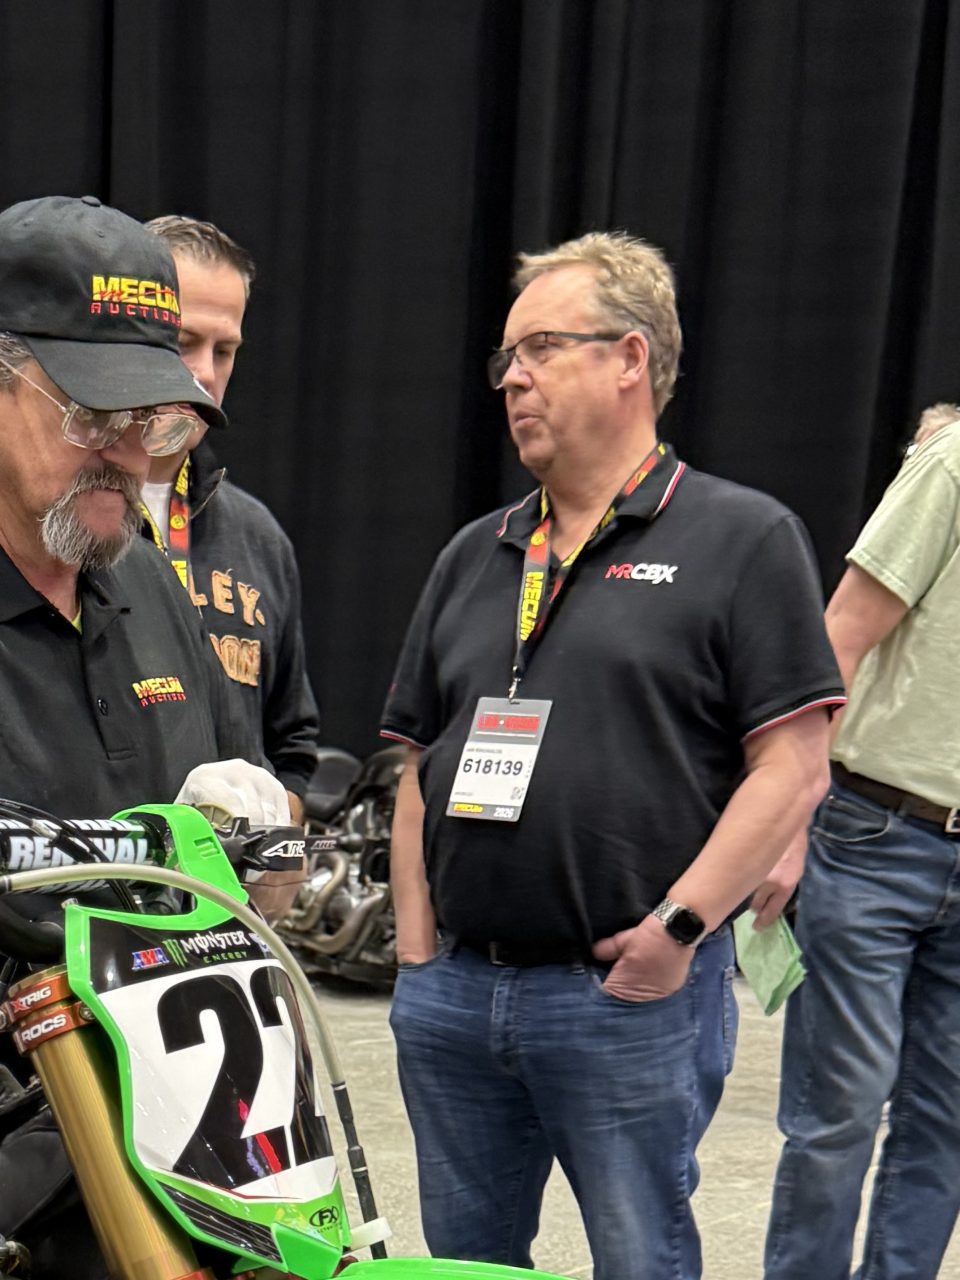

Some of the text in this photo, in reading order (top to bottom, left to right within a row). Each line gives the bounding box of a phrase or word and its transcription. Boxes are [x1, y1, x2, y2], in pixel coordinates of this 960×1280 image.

[519, 571, 544, 641] MECUM
[462, 758, 523, 776] 618139
[180, 930, 251, 955] MONSTER
[202, 951, 248, 964] ENERGY
[10, 986, 52, 1014] XTRIG
[21, 1013, 67, 1042] ROCS
[157, 965, 335, 1182] 22
